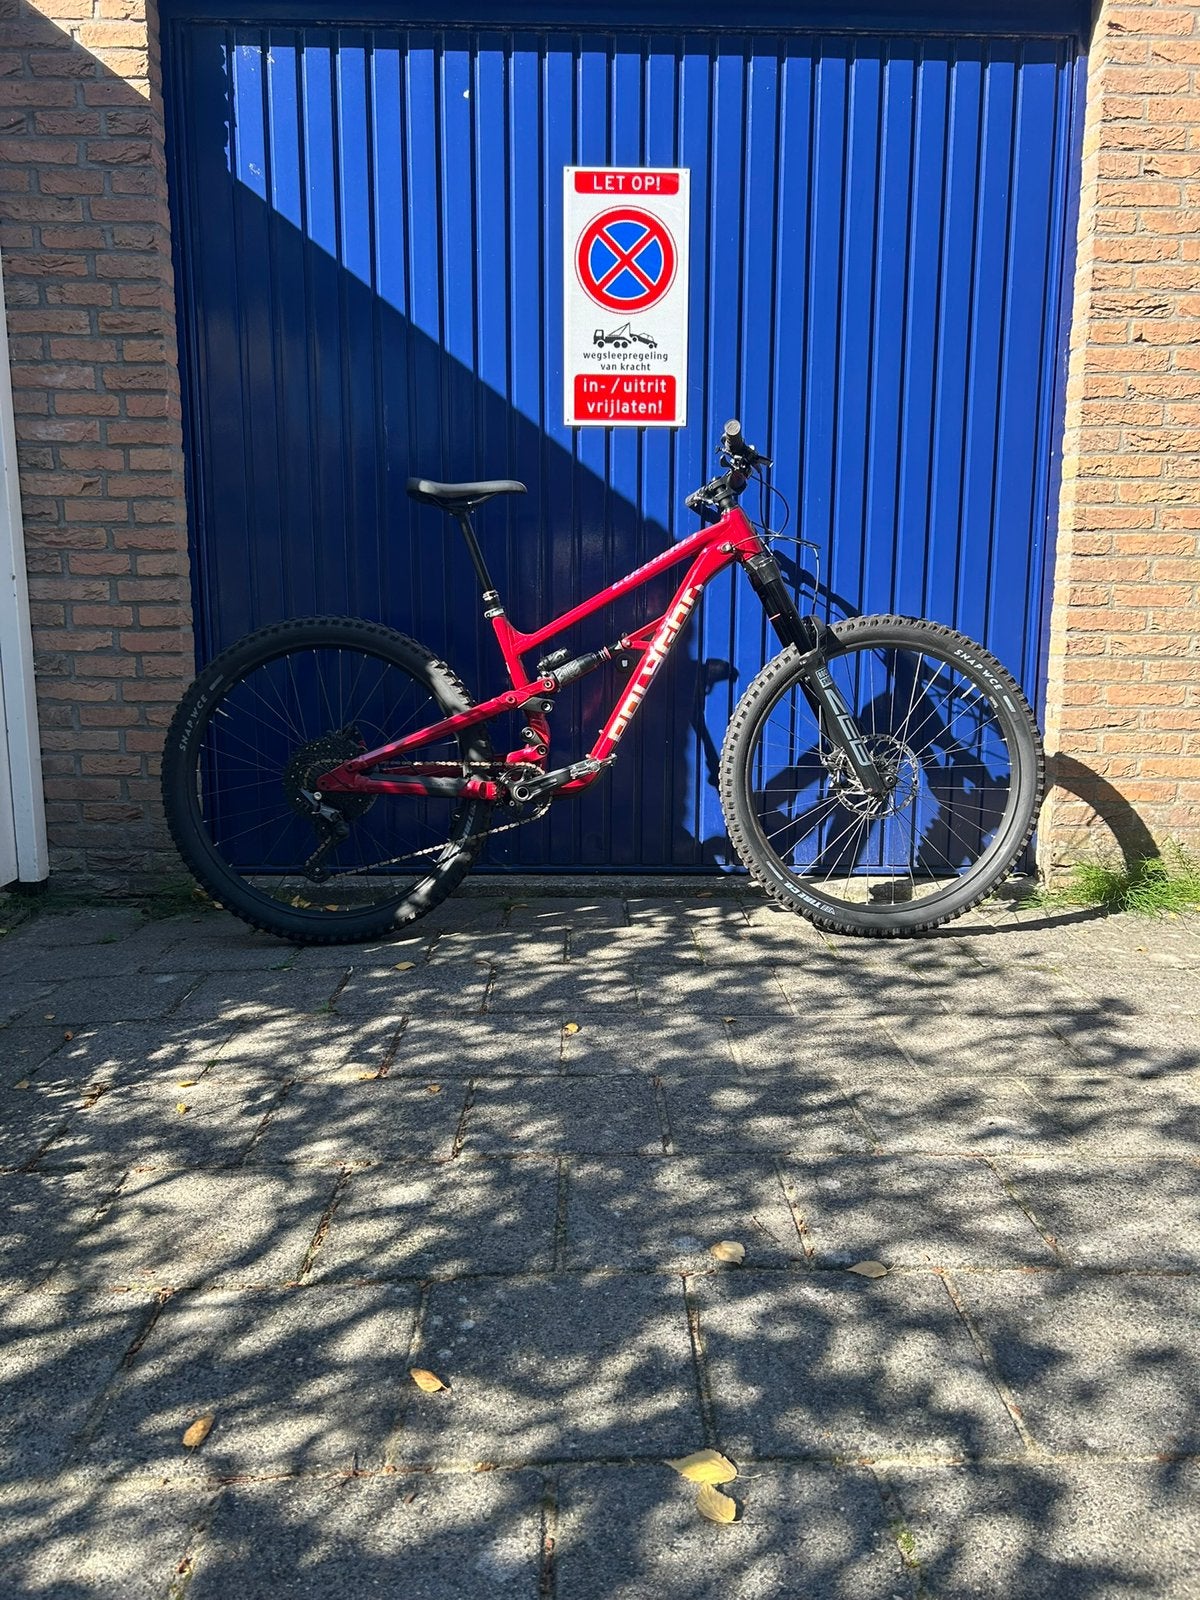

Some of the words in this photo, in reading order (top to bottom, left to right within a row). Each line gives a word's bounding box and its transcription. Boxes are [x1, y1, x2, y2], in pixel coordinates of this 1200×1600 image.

[593, 175, 625, 191] LET
[631, 176, 661, 192] OP!
[583, 351, 668, 363] wegsleepregeling
[600, 363, 618, 371] van
[621, 362, 651, 371] kracht
[586, 399, 663, 417] vrijlaten!
[953, 649, 984, 674] SNAP
[982, 668, 1003, 691] WCE
[179, 719, 194, 751] SNAP
[190, 694, 209, 719] WCE
